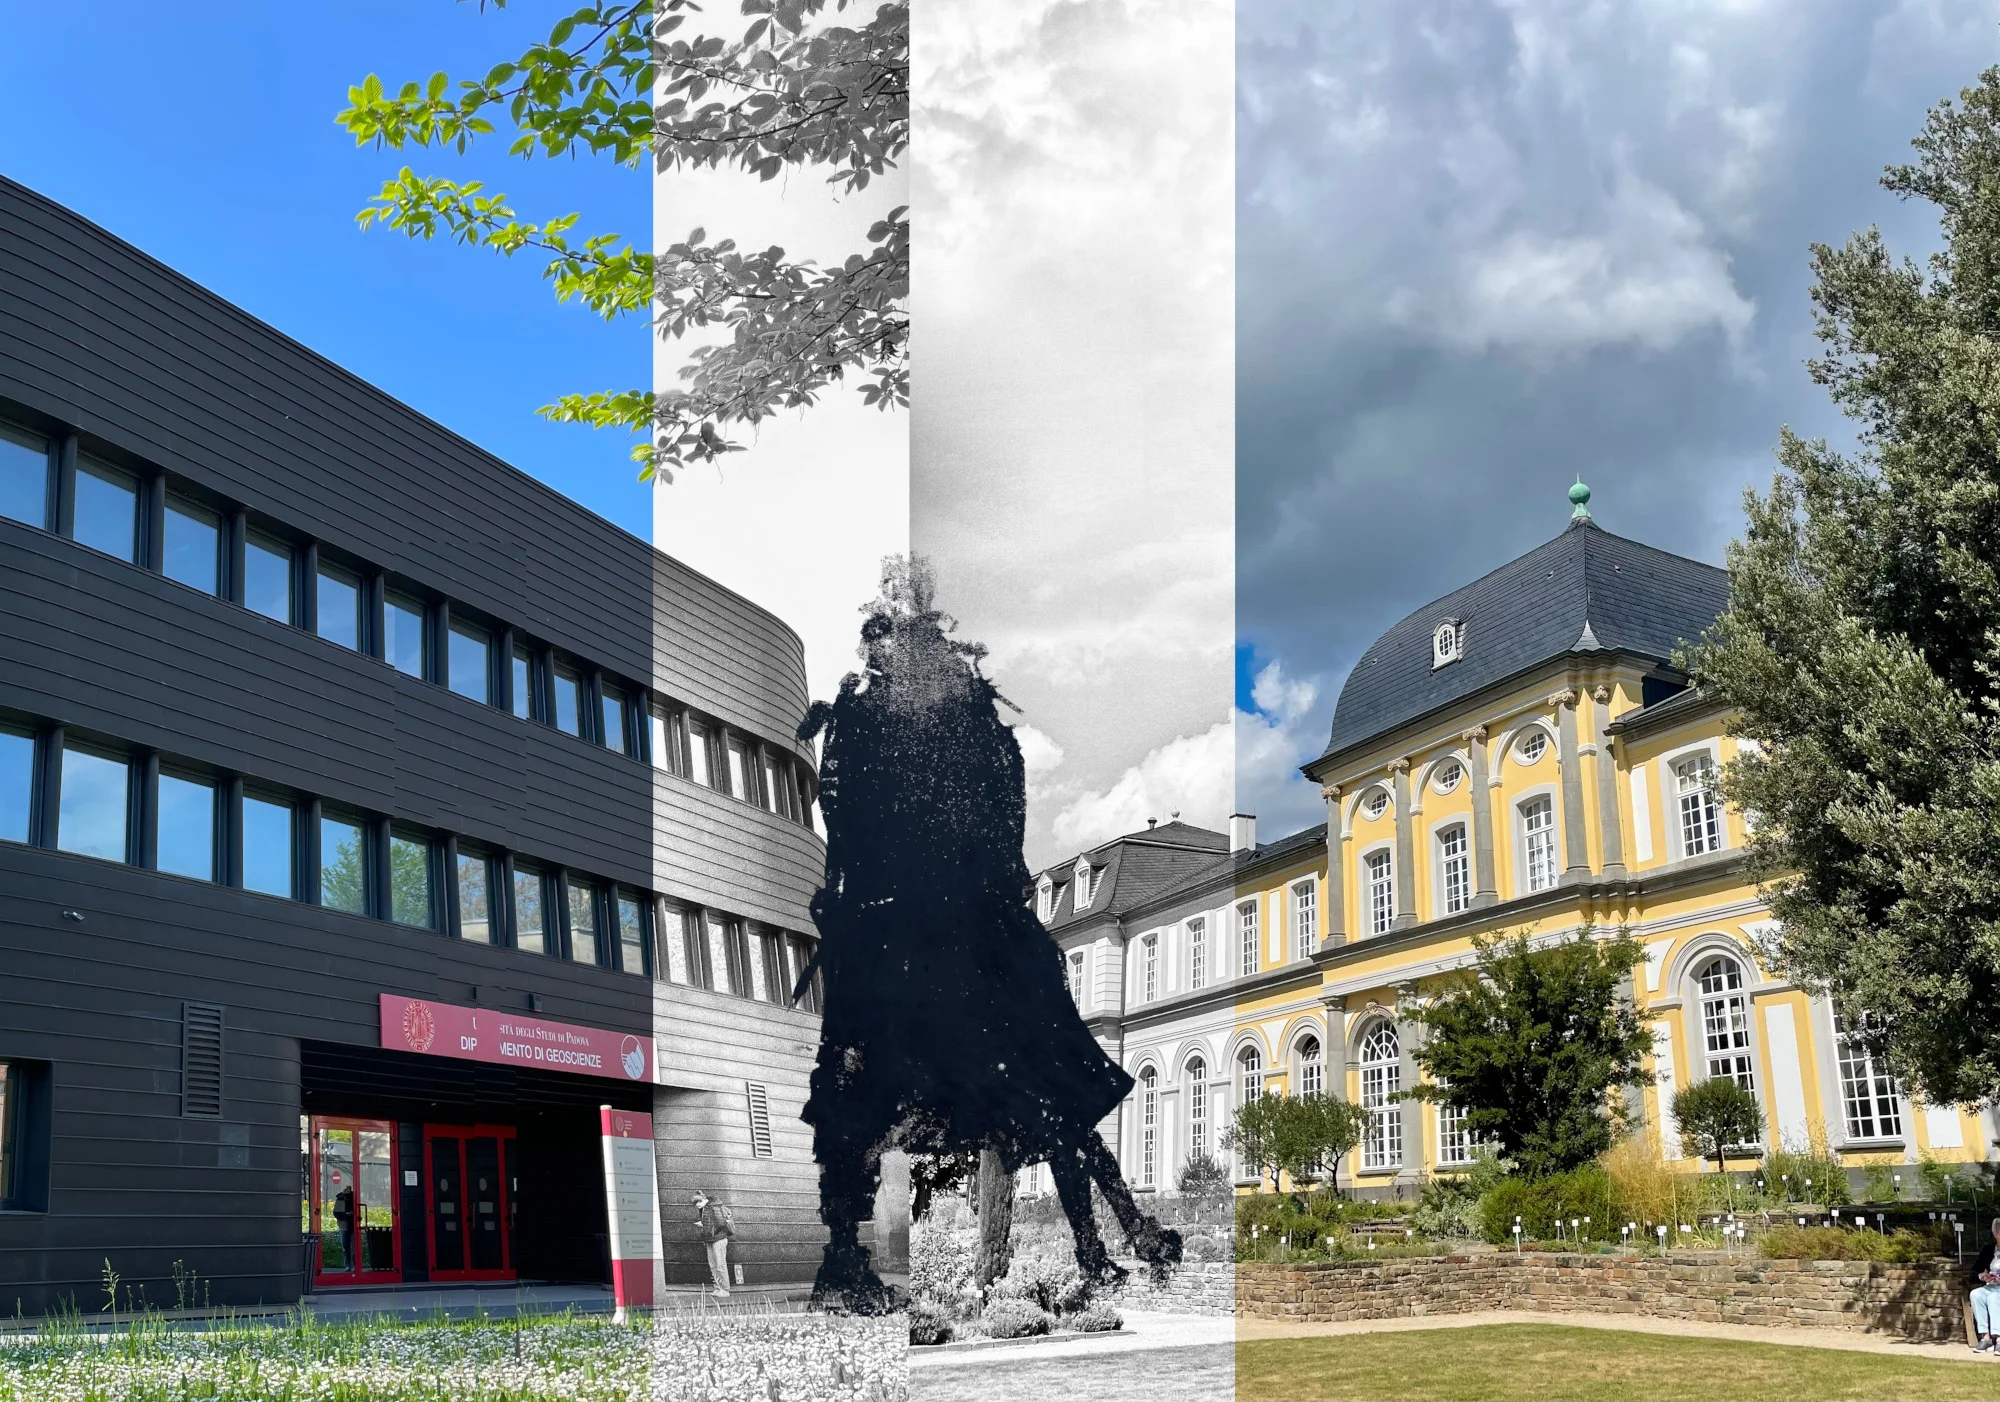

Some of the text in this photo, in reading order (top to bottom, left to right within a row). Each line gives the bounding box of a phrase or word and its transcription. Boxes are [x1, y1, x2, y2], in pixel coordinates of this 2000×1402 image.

[460, 1035, 478, 1051] DIP
[534, 1046, 544, 1060] DI
[546, 1048, 602, 1068] GEOSCIENZE
